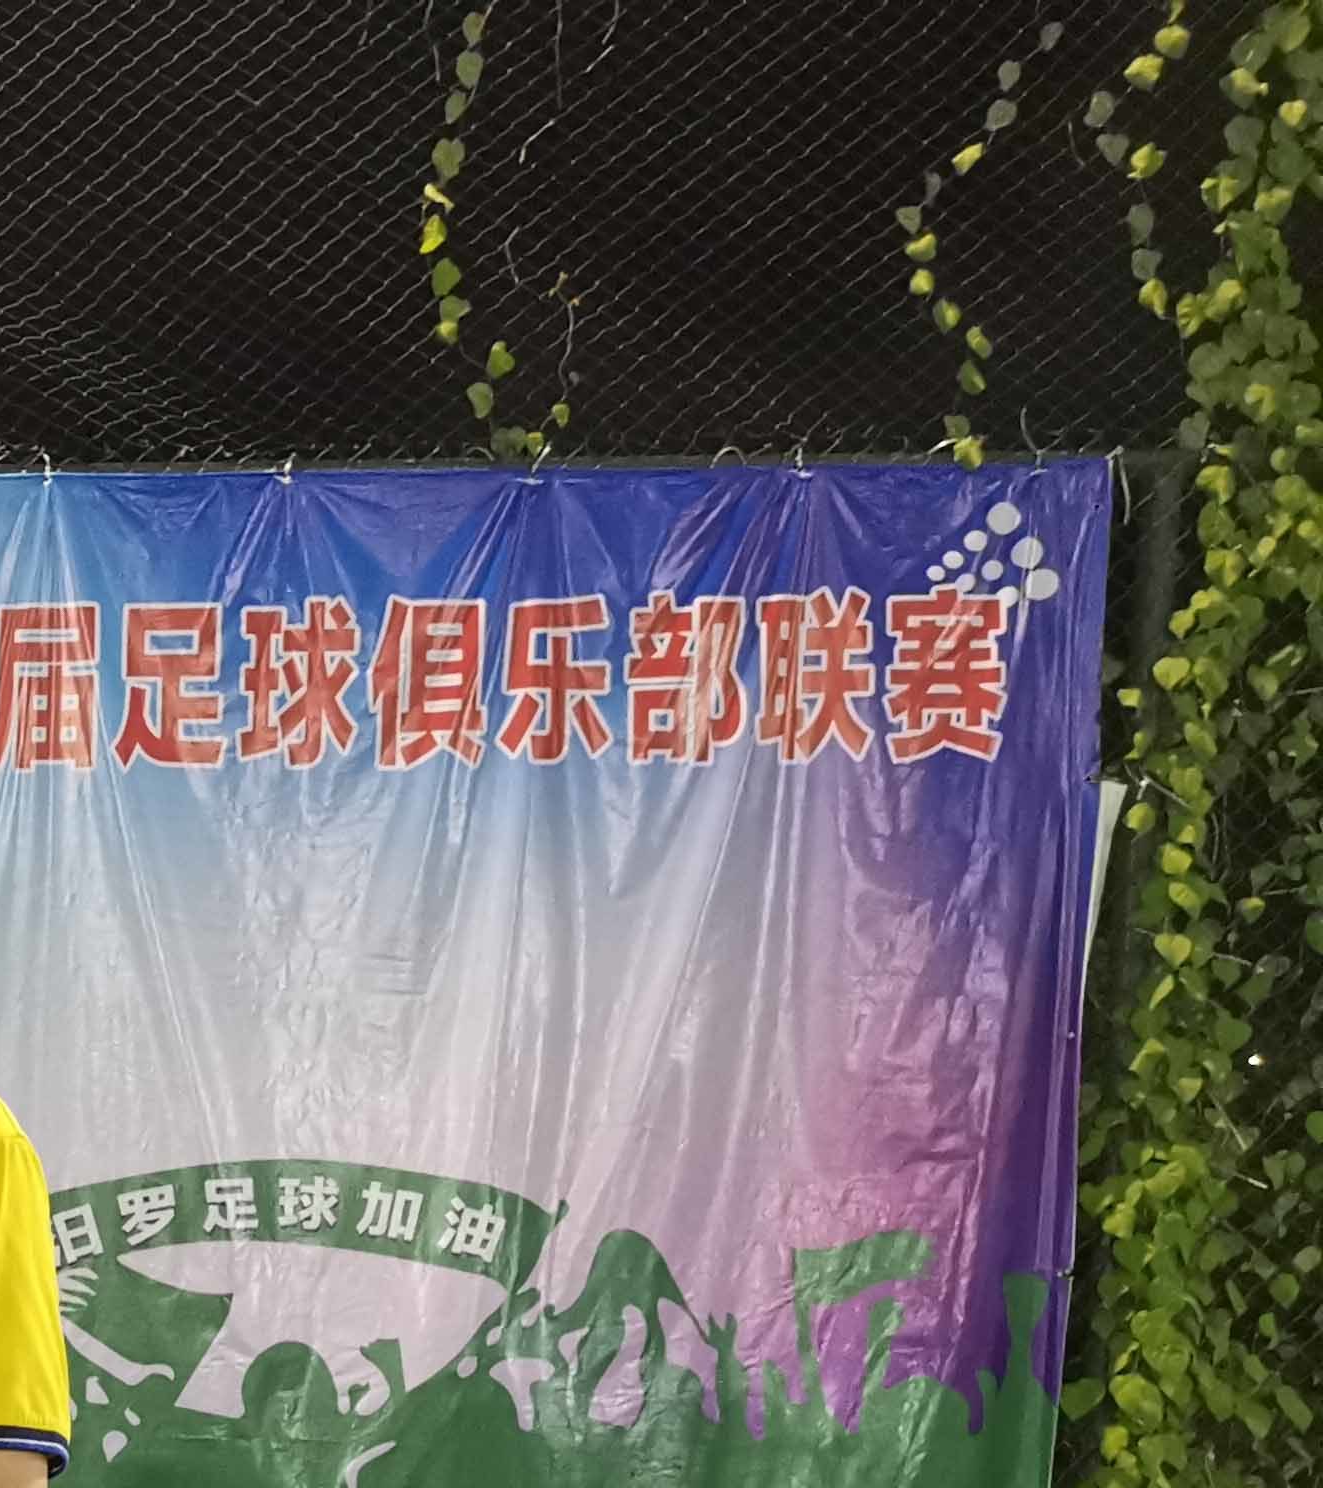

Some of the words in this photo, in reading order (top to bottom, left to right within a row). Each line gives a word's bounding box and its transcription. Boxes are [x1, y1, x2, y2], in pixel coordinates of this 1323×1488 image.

[53, 1176, 506, 1270] 汨罗足球加油
